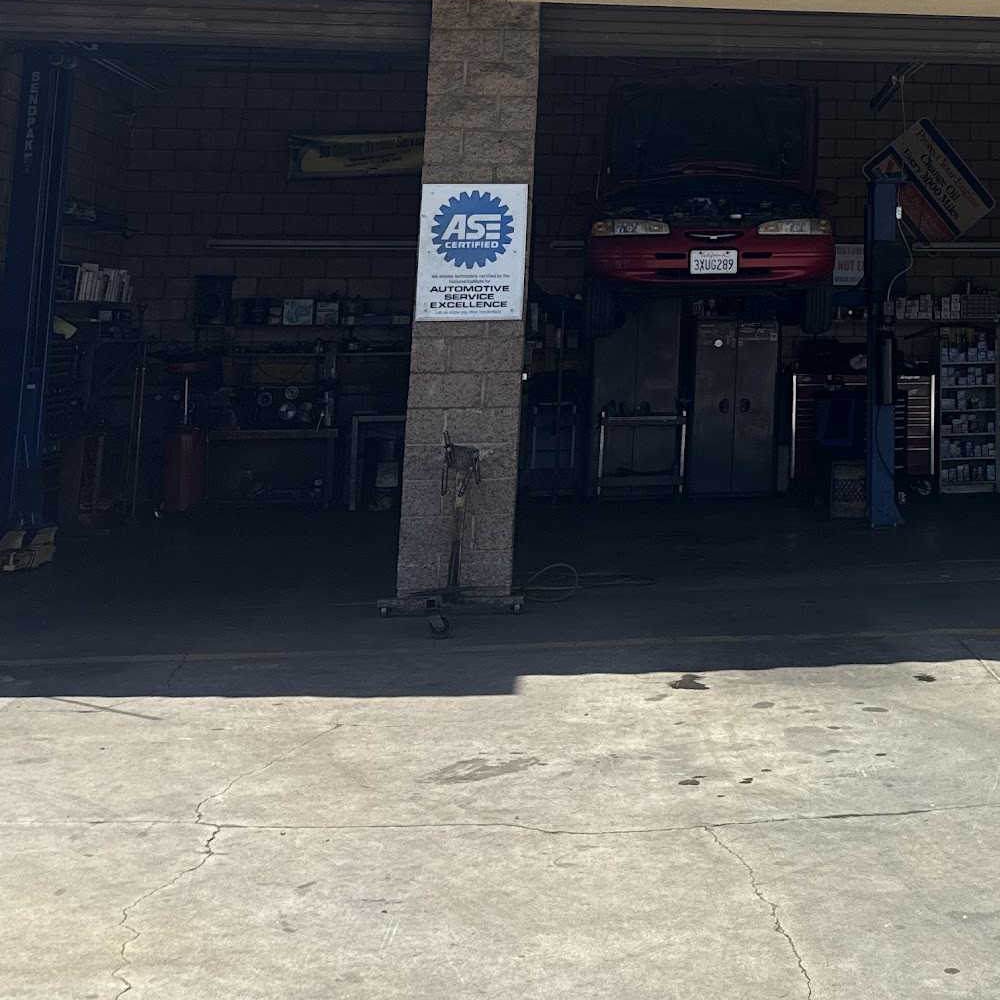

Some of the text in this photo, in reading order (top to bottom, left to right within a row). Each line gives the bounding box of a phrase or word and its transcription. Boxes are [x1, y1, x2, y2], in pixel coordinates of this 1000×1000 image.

[24, 71, 40, 151] BENDPAK
[396, 133, 424, 148] Servic
[899, 147, 926, 176] Every
[937, 193, 962, 220] Miles
[917, 152, 950, 188] Change
[943, 183, 961, 202] Oil
[441, 214, 502, 241] ASE
[445, 241, 499, 249] CERTIFIED
[694, 259, 734, 271] 3XUG289
